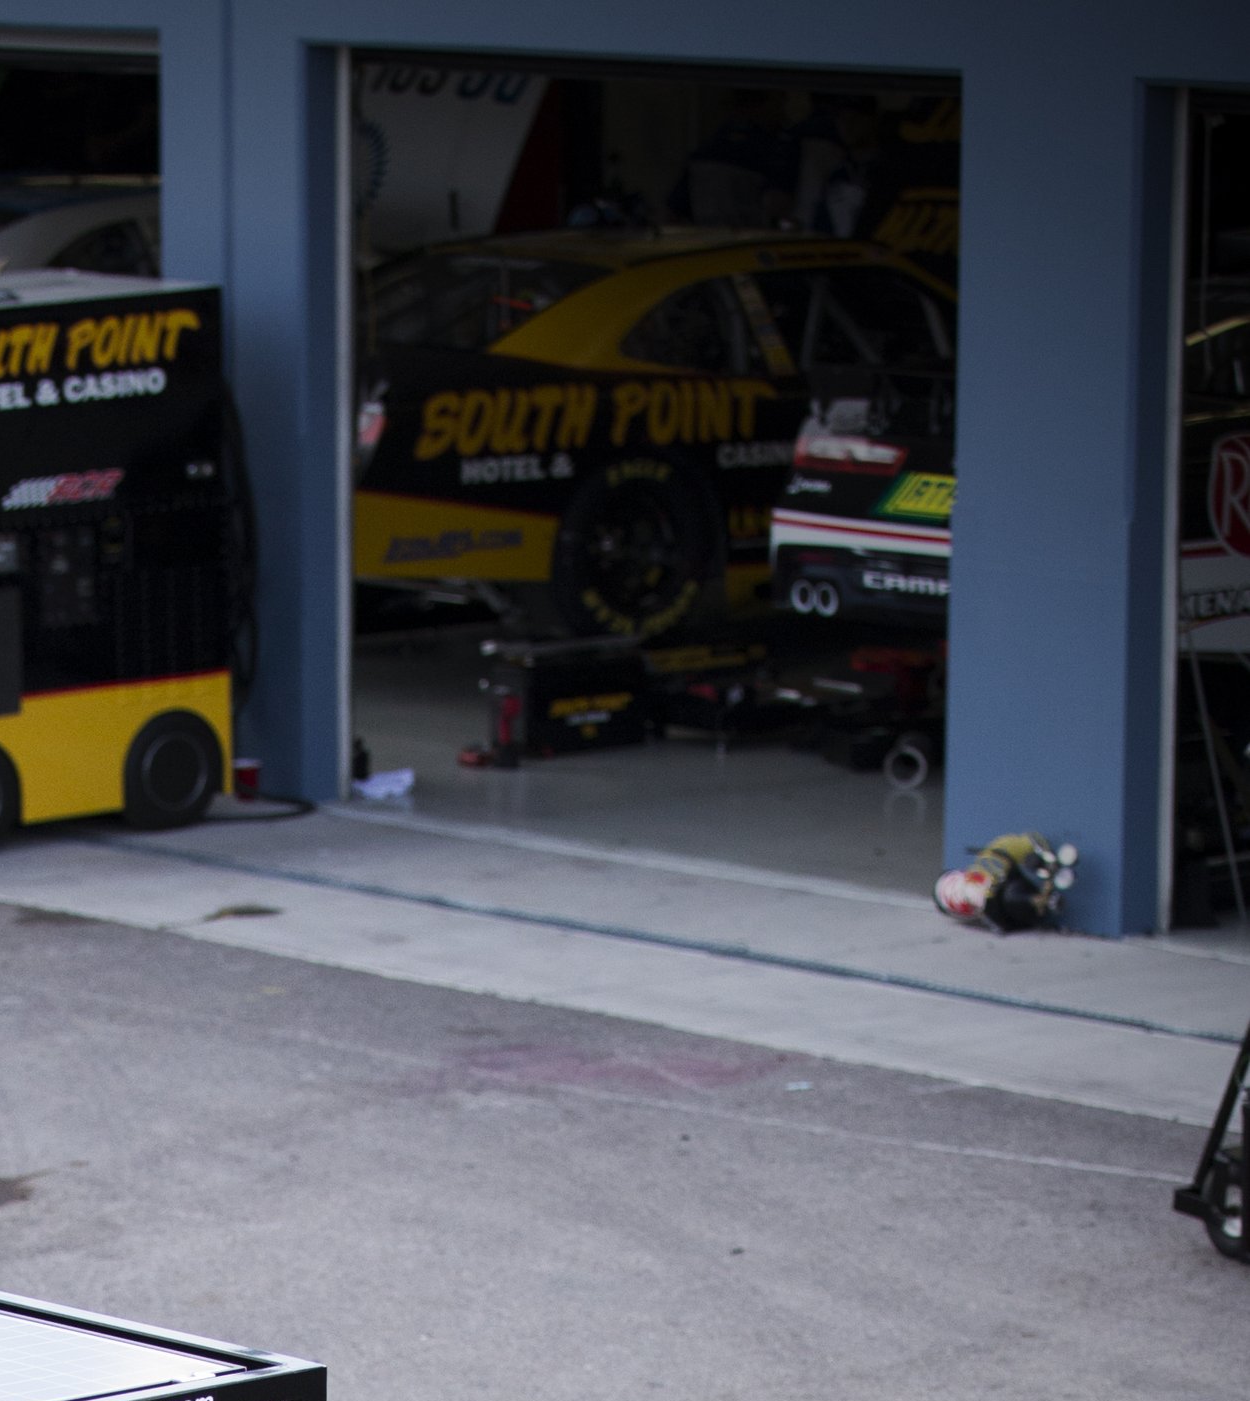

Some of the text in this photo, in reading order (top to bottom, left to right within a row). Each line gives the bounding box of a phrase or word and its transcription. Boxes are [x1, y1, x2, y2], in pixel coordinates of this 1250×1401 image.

[66, 308, 201, 371] POINT
[34, 376, 60, 407] &
[63, 366, 168, 402] CASINO
[413, 377, 779, 461] SOUTH POINT
[461, 452, 547, 486] HOTEL
[715, 438, 795, 470] CASIN
